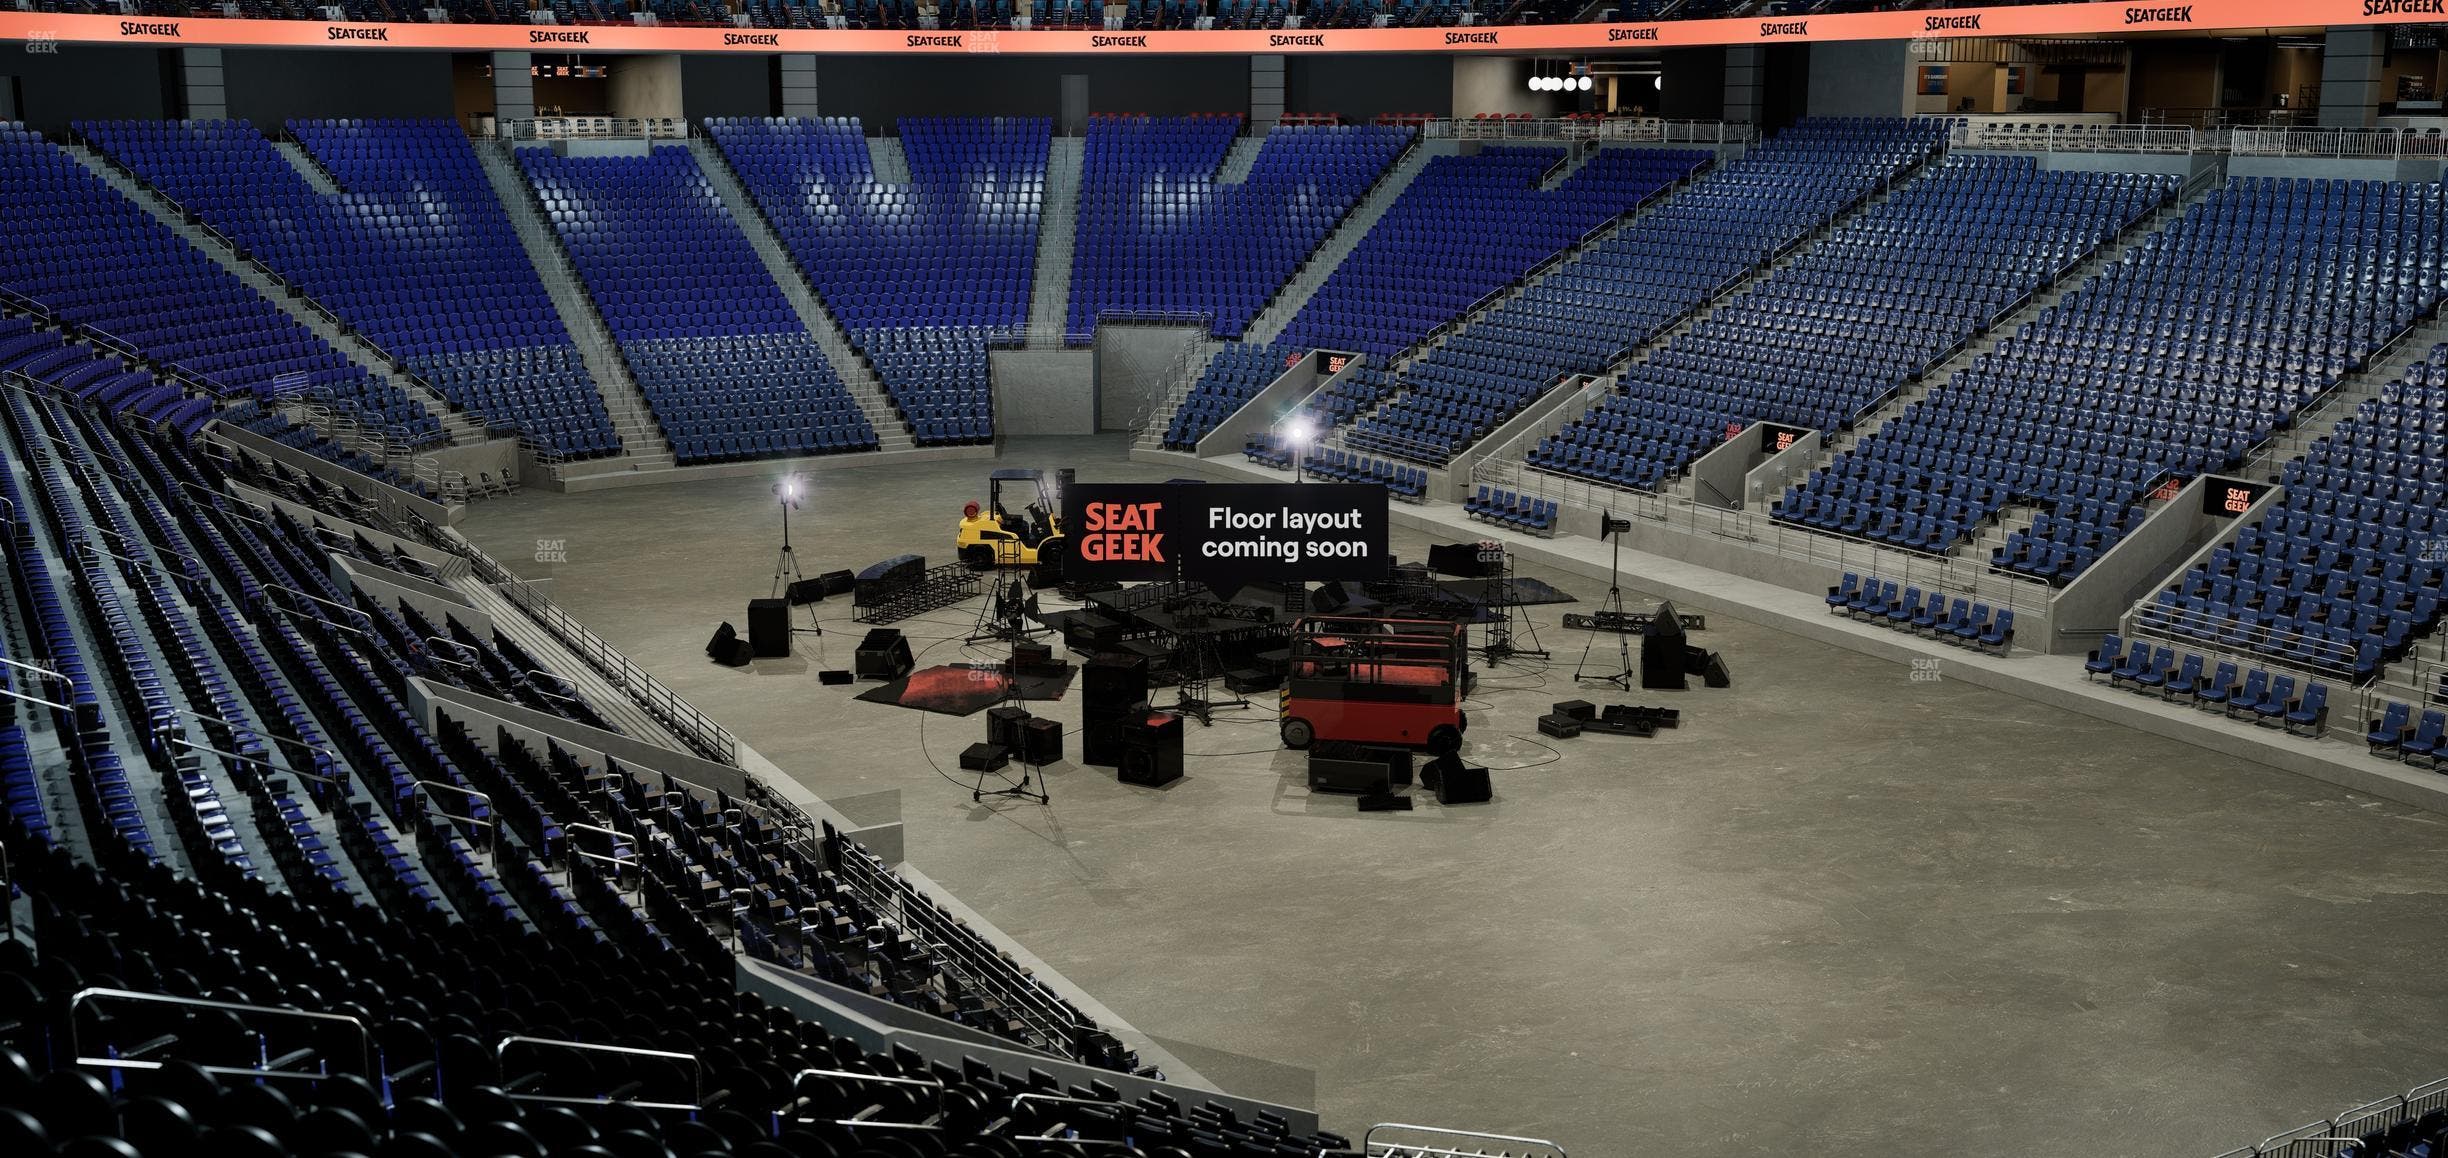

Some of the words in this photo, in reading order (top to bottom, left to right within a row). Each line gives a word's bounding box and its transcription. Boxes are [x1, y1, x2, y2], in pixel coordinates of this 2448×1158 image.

[2124, 5, 2193, 25] SEATGEEK
[2362, 0, 2445, 16] SEATGEEK
[120, 21, 180, 37] SEATGEEK
[1760, 21, 1808, 37] SEATGEEK
[1924, 13, 1981, 32] SEATGEEK
[327, 26, 388, 42] SEATGEEK
[529, 30, 590, 45] SEATGEEK
[724, 33, 779, 46] SEATGEEK
[1269, 34, 1324, 47] SEATGEEK
[1444, 31, 1499, 45] SEATGEEK
[1608, 27, 1659, 42] SEATGEEK
[907, 35, 962, 48] SEATGEEK
[1091, 35, 1147, 48] SEATGEEK
[1329, 356, 1346, 366] SEAT
[1328, 365, 1344, 373] GEE
[1777, 431, 1794, 443] SEAT
[1776, 441, 1791, 450] GEE
[2226, 487, 2251, 502] SEAT
[2224, 500, 2250, 513] GEEK
